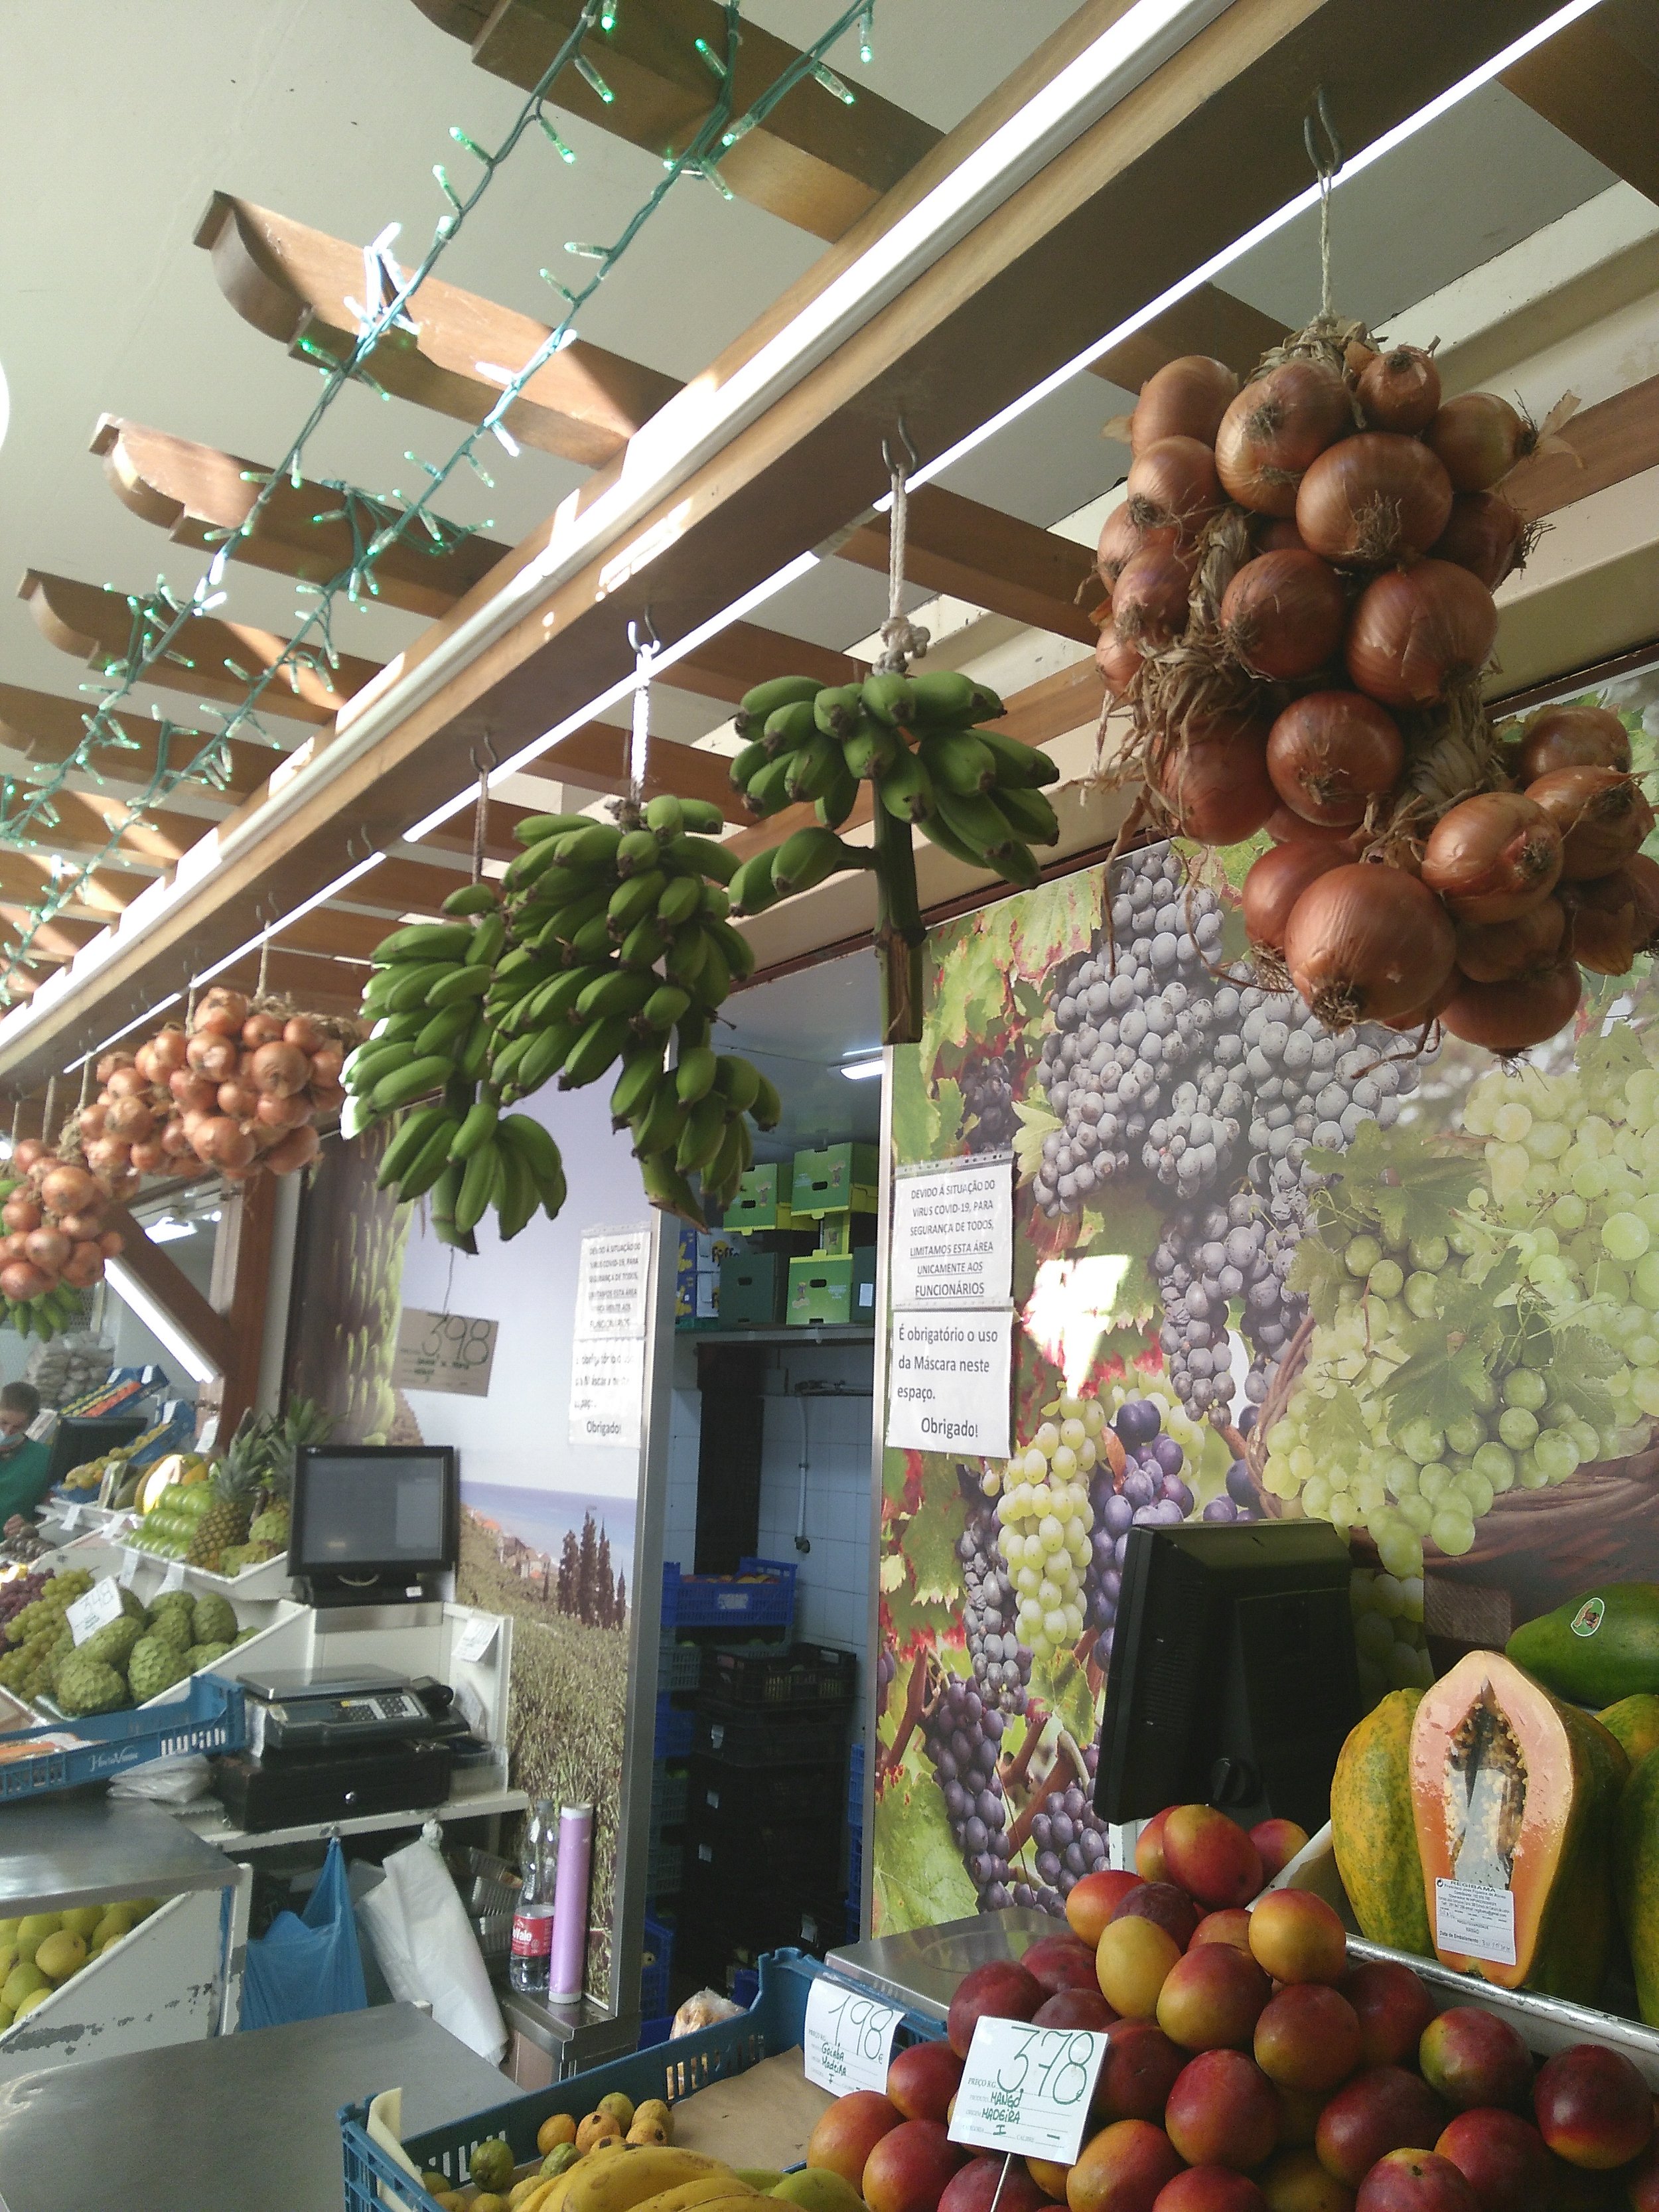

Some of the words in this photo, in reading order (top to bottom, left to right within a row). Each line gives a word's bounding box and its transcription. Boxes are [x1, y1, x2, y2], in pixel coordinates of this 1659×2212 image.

[911, 1187, 938, 1199] DEVIDO
[939, 1183, 945, 1195] Á
[946, 1180, 983, 1195] SITUAÇÃO
[984, 1179, 995, 1190] DO
[934, 1202, 972, 1215] COVID-19,
[973, 1200, 993, 1211] PARA
[910, 1224, 953, 1236] SEGURANÇA
[955, 1223, 965, 1232] DE
[967, 1219, 993, 1232] TODOS,
[910, 1244, 952, 1257] LIMITAMOS
[953, 1244, 972, 1254] ESTA
[974, 1240, 993, 1252] ÁREA
[966, 1261, 983, 1272] AOS
[915, 1280, 984, 1296] FUNCIONÁRIOS
[899, 1323, 904, 1341] É
[907, 1327, 964, 1345] obrigatório
[967, 1331, 975, 1342] o
[978, 1331, 998, 1343] uso
[899, 1355, 911, 1370] da
[914, 1356, 956, 1372] Máscara
[959, 1359, 989, 1372] neste
[897, 1386, 936, 1402] espaço.
[921, 1418, 978, 1439] Obrigado!
[968, 2077, 987, 2087] PREÇO
